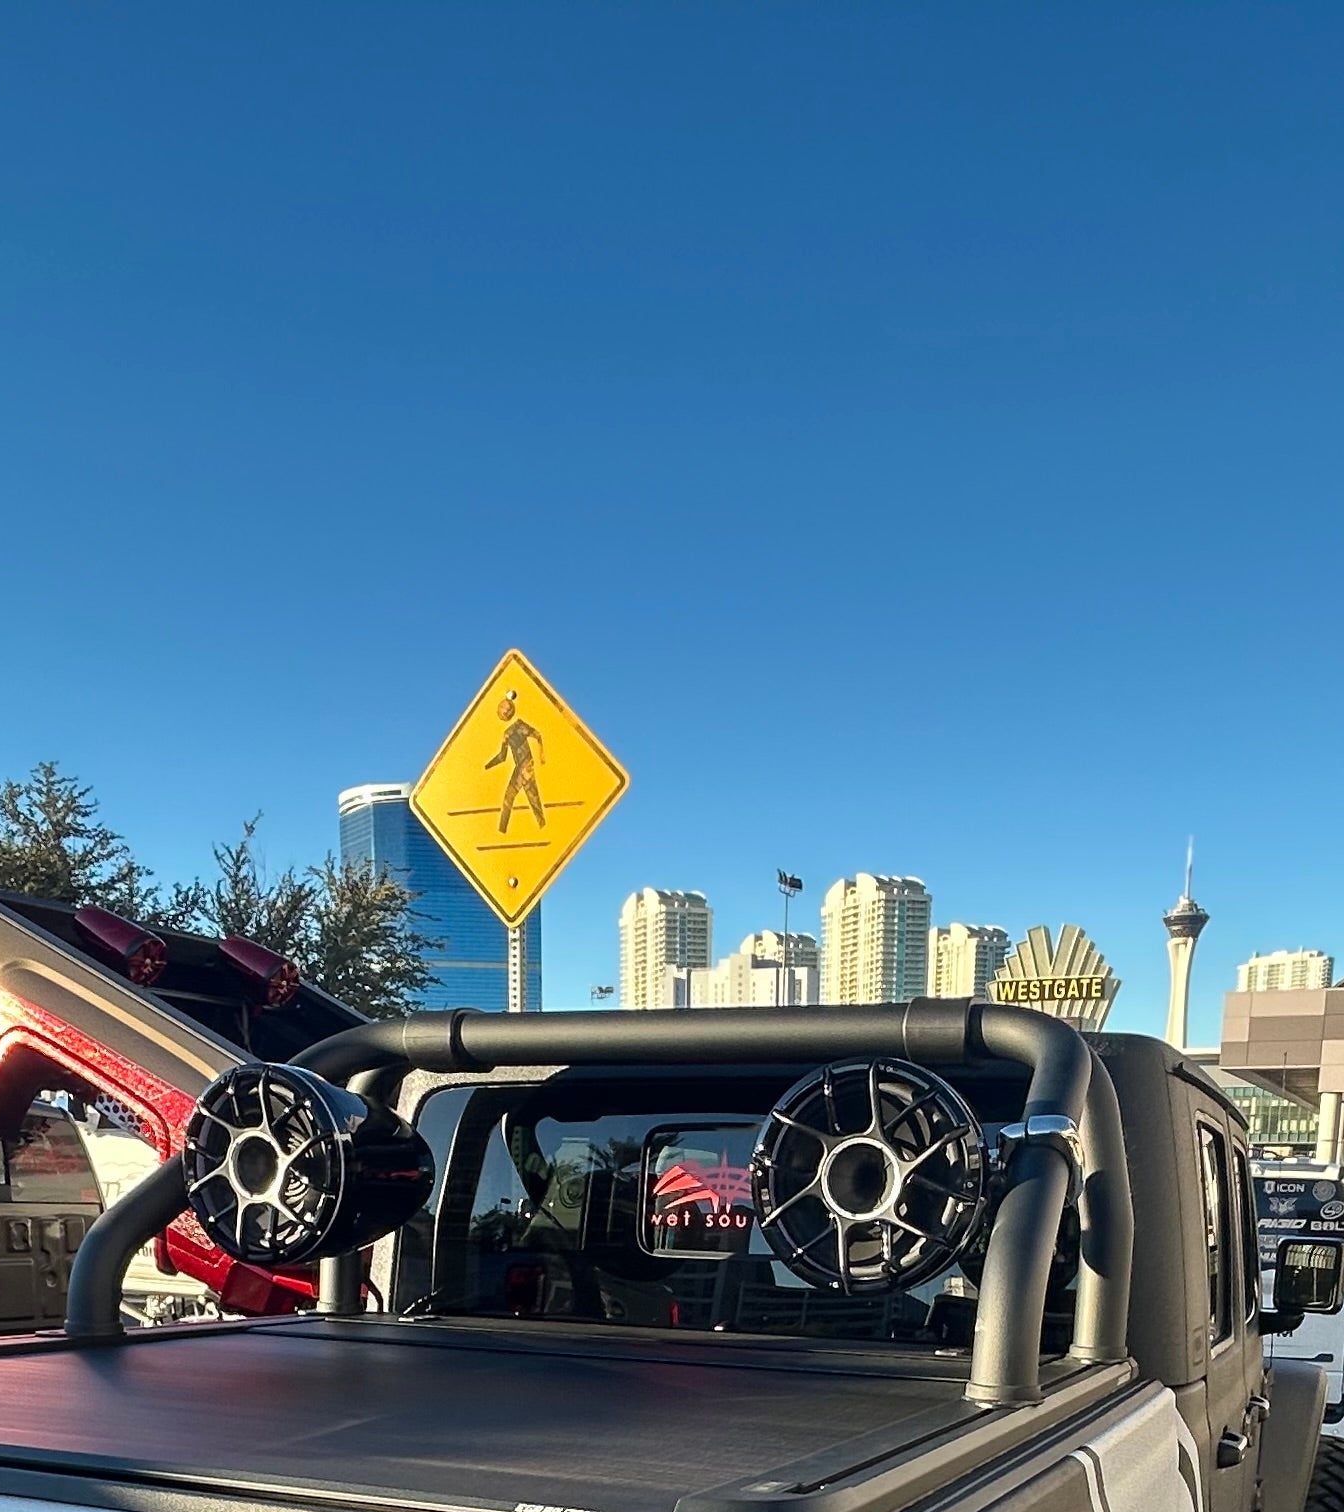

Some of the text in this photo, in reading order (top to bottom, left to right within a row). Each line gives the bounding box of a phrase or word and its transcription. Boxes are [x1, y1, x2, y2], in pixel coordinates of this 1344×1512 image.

[998, 978, 1103, 1001] WESTGATE
[1276, 1183, 1305, 1193] ICON
[705, 1213, 747, 1228] sou
